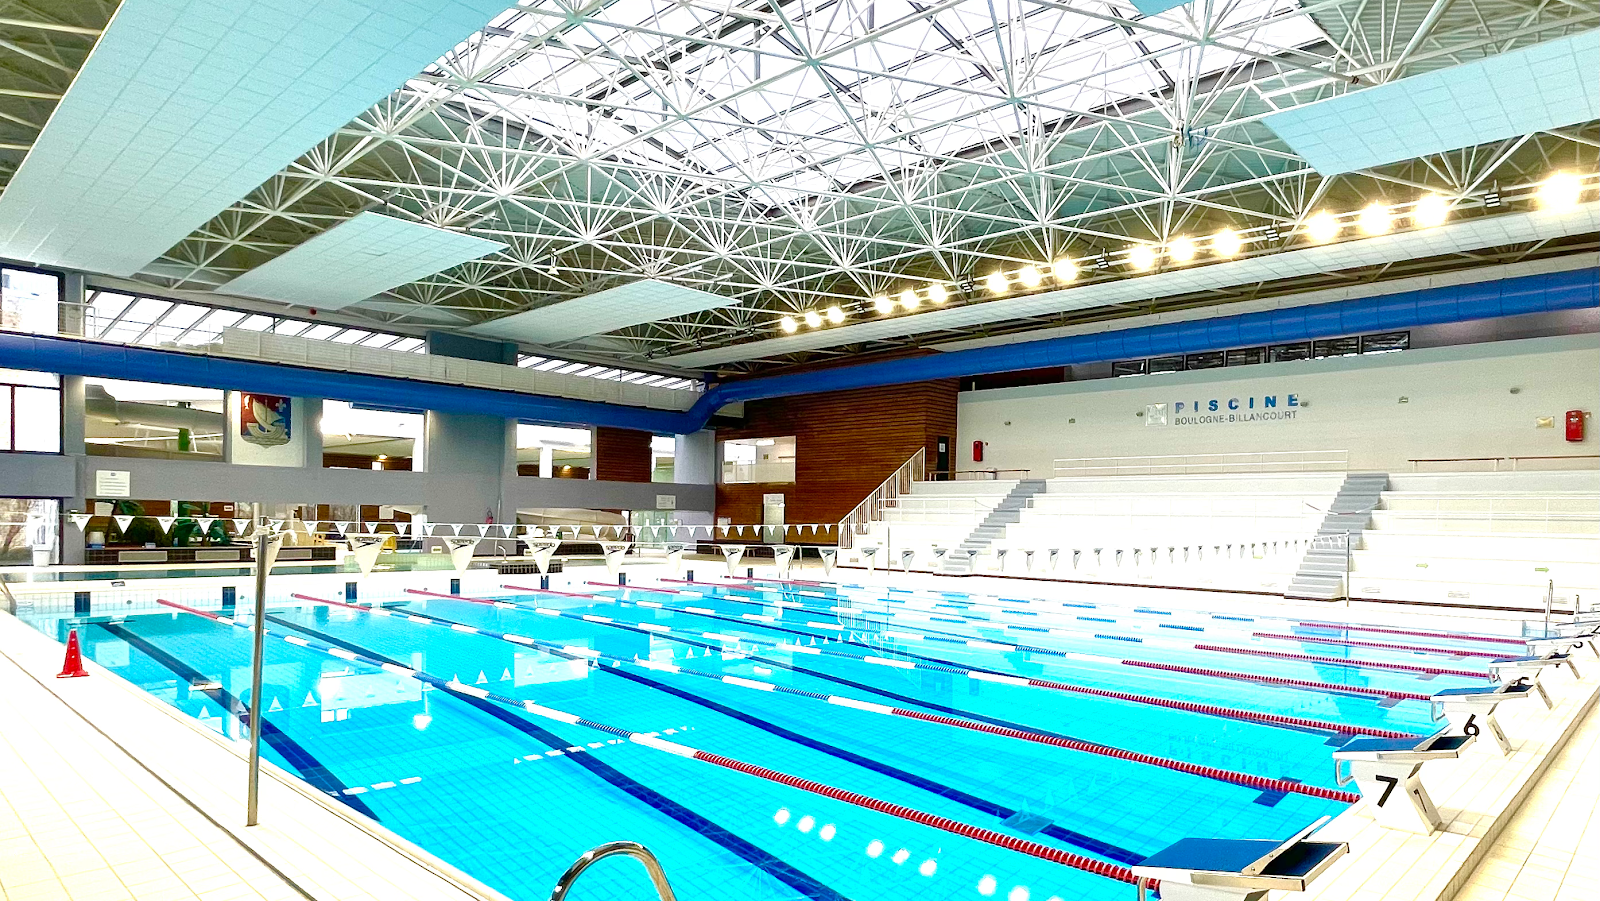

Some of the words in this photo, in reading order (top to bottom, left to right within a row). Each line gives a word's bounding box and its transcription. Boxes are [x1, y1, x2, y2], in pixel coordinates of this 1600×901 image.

[1175, 393, 1299, 414] PISCINE
[1174, 410, 1298, 426] BOULOGNE-BILLANCOURT
[1463, 714, 1480, 737] 6
[1375, 774, 1399, 808] 7
